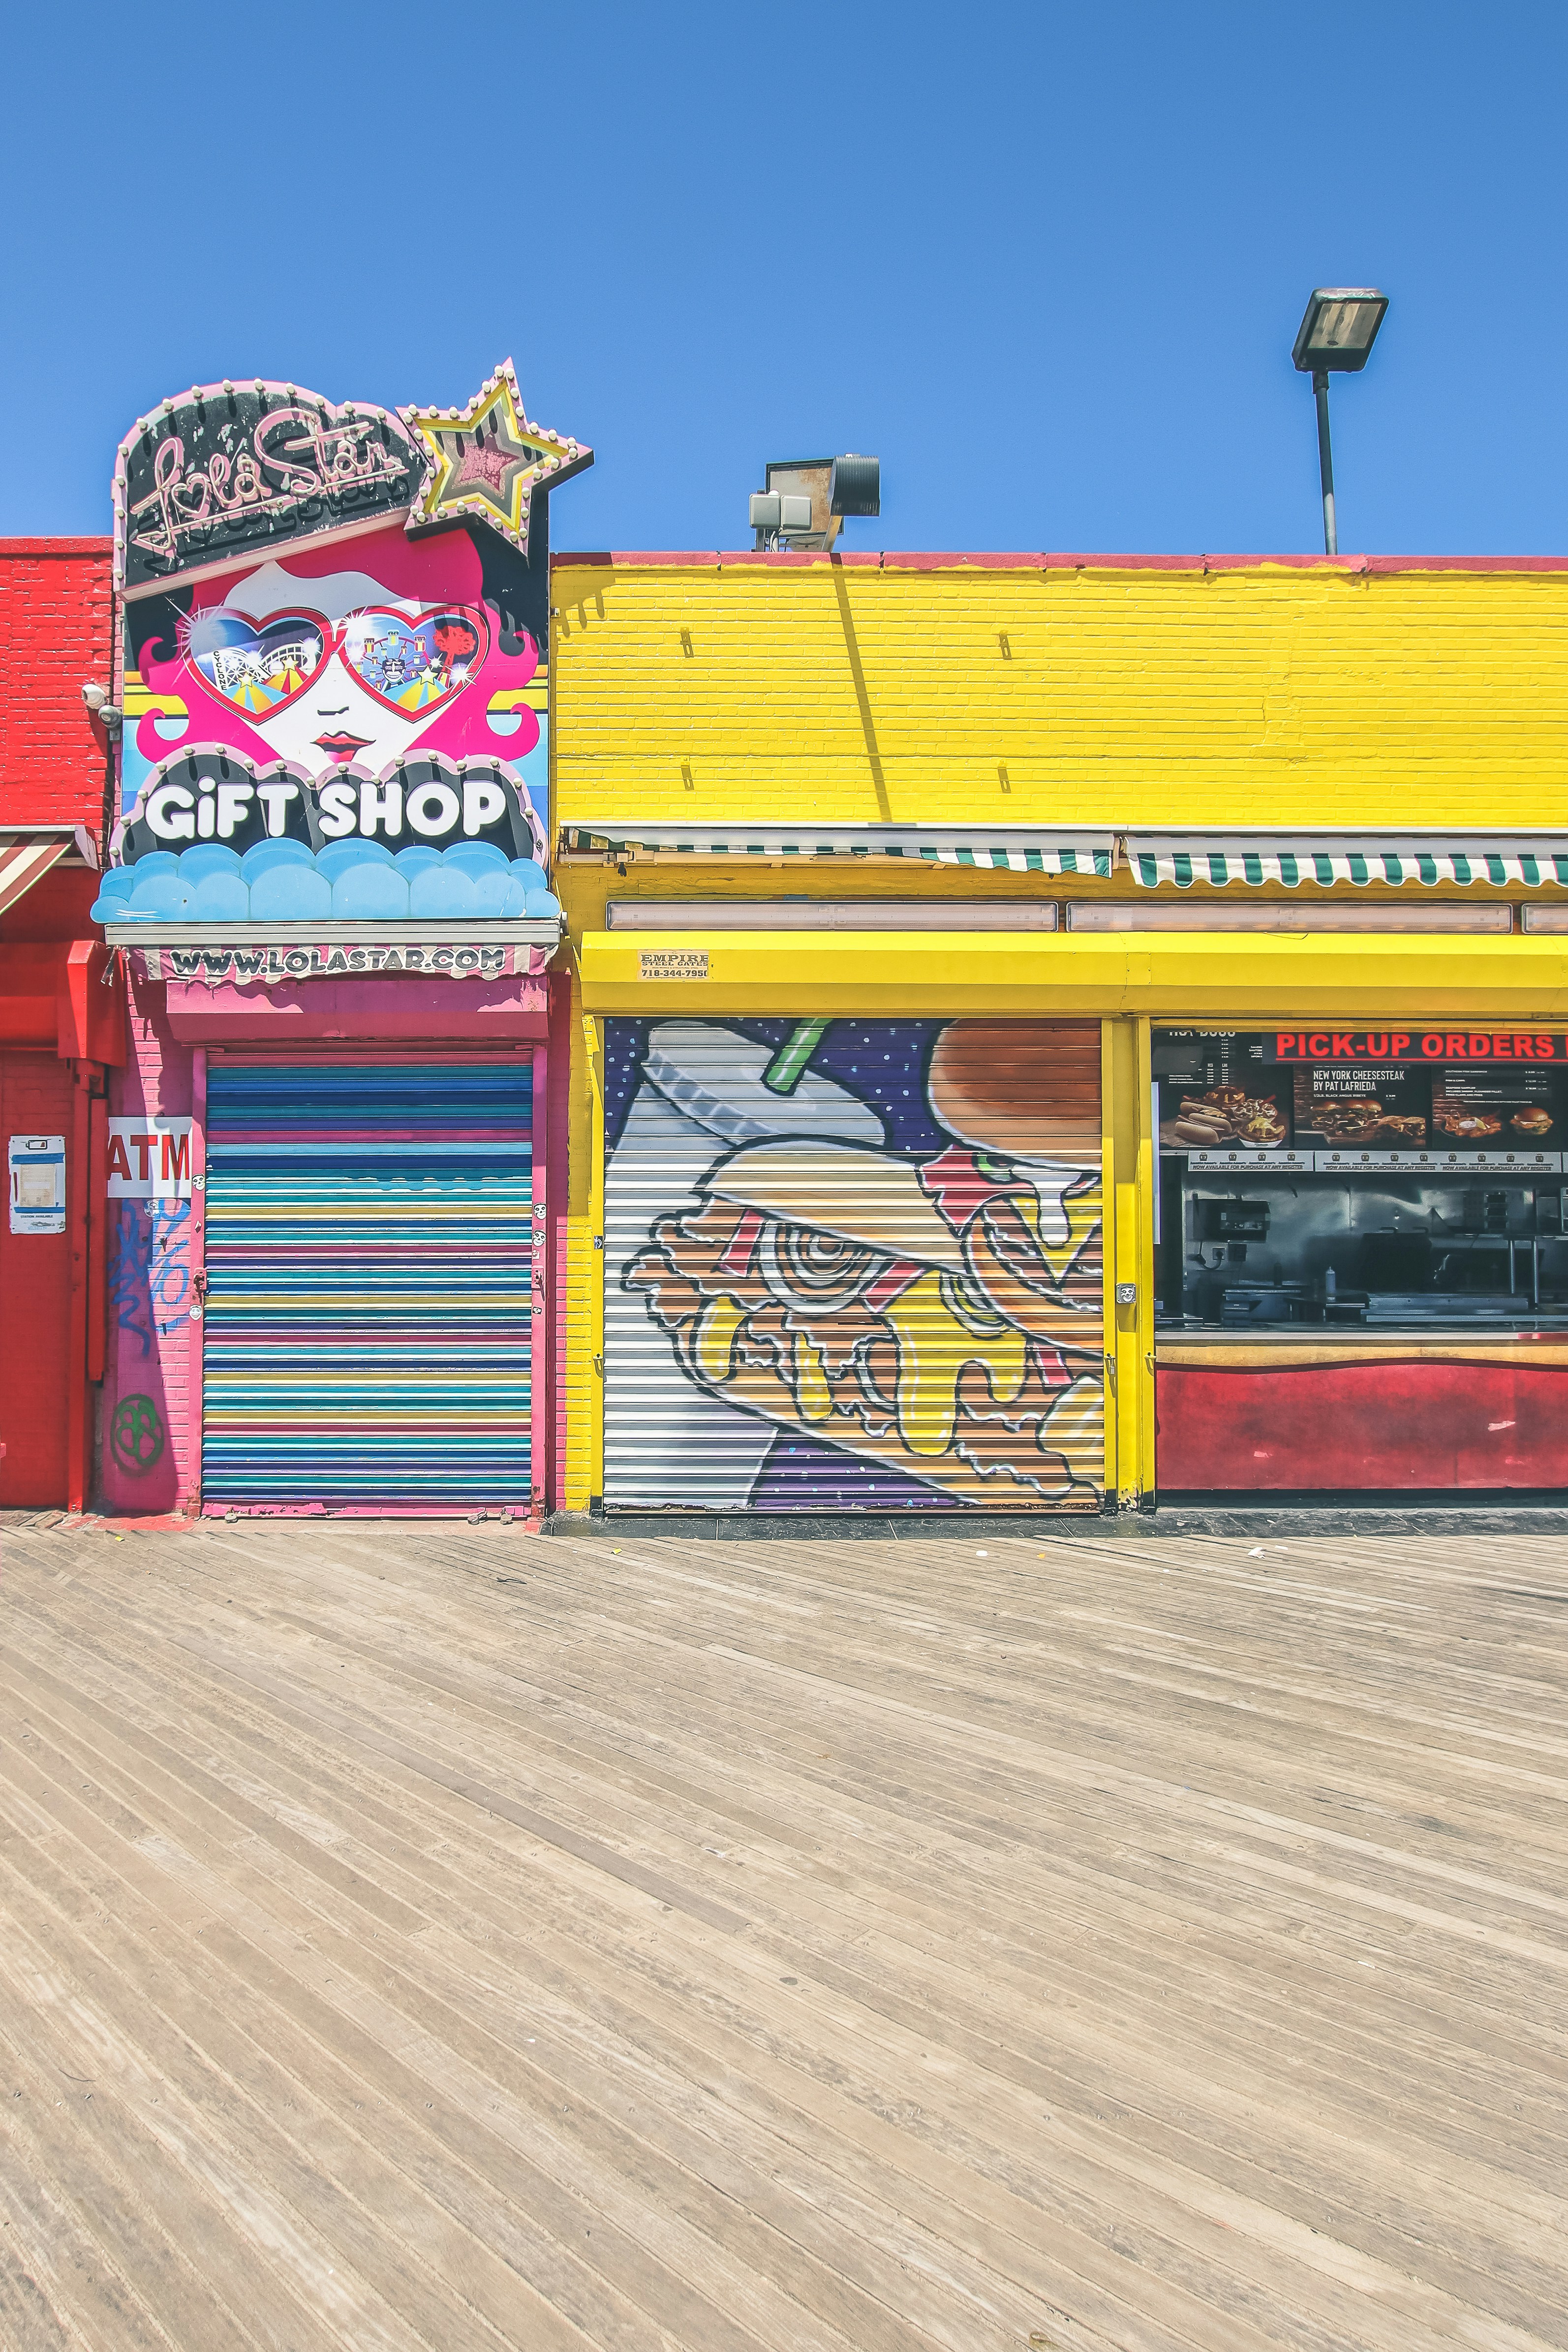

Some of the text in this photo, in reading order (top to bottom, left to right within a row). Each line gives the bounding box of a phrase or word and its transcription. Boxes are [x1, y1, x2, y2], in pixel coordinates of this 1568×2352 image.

[254, 406, 408, 497] Star
[213, 651, 227, 691] CYCLONE
[318, 779, 507, 838] SHOP
[170, 946, 506, 976] WWW.LOLASTAR.COM
[1276, 1034, 1410, 1057] PICK-UP
[1421, 1034, 1555, 1058] ORDERS
[1313, 1070, 1405, 1080] NEW YORK CHEESESTEAK
[1313, 1081, 1377, 1091] BY PAT LAFRIEDA
[107, 1134, 190, 1181] ATM
